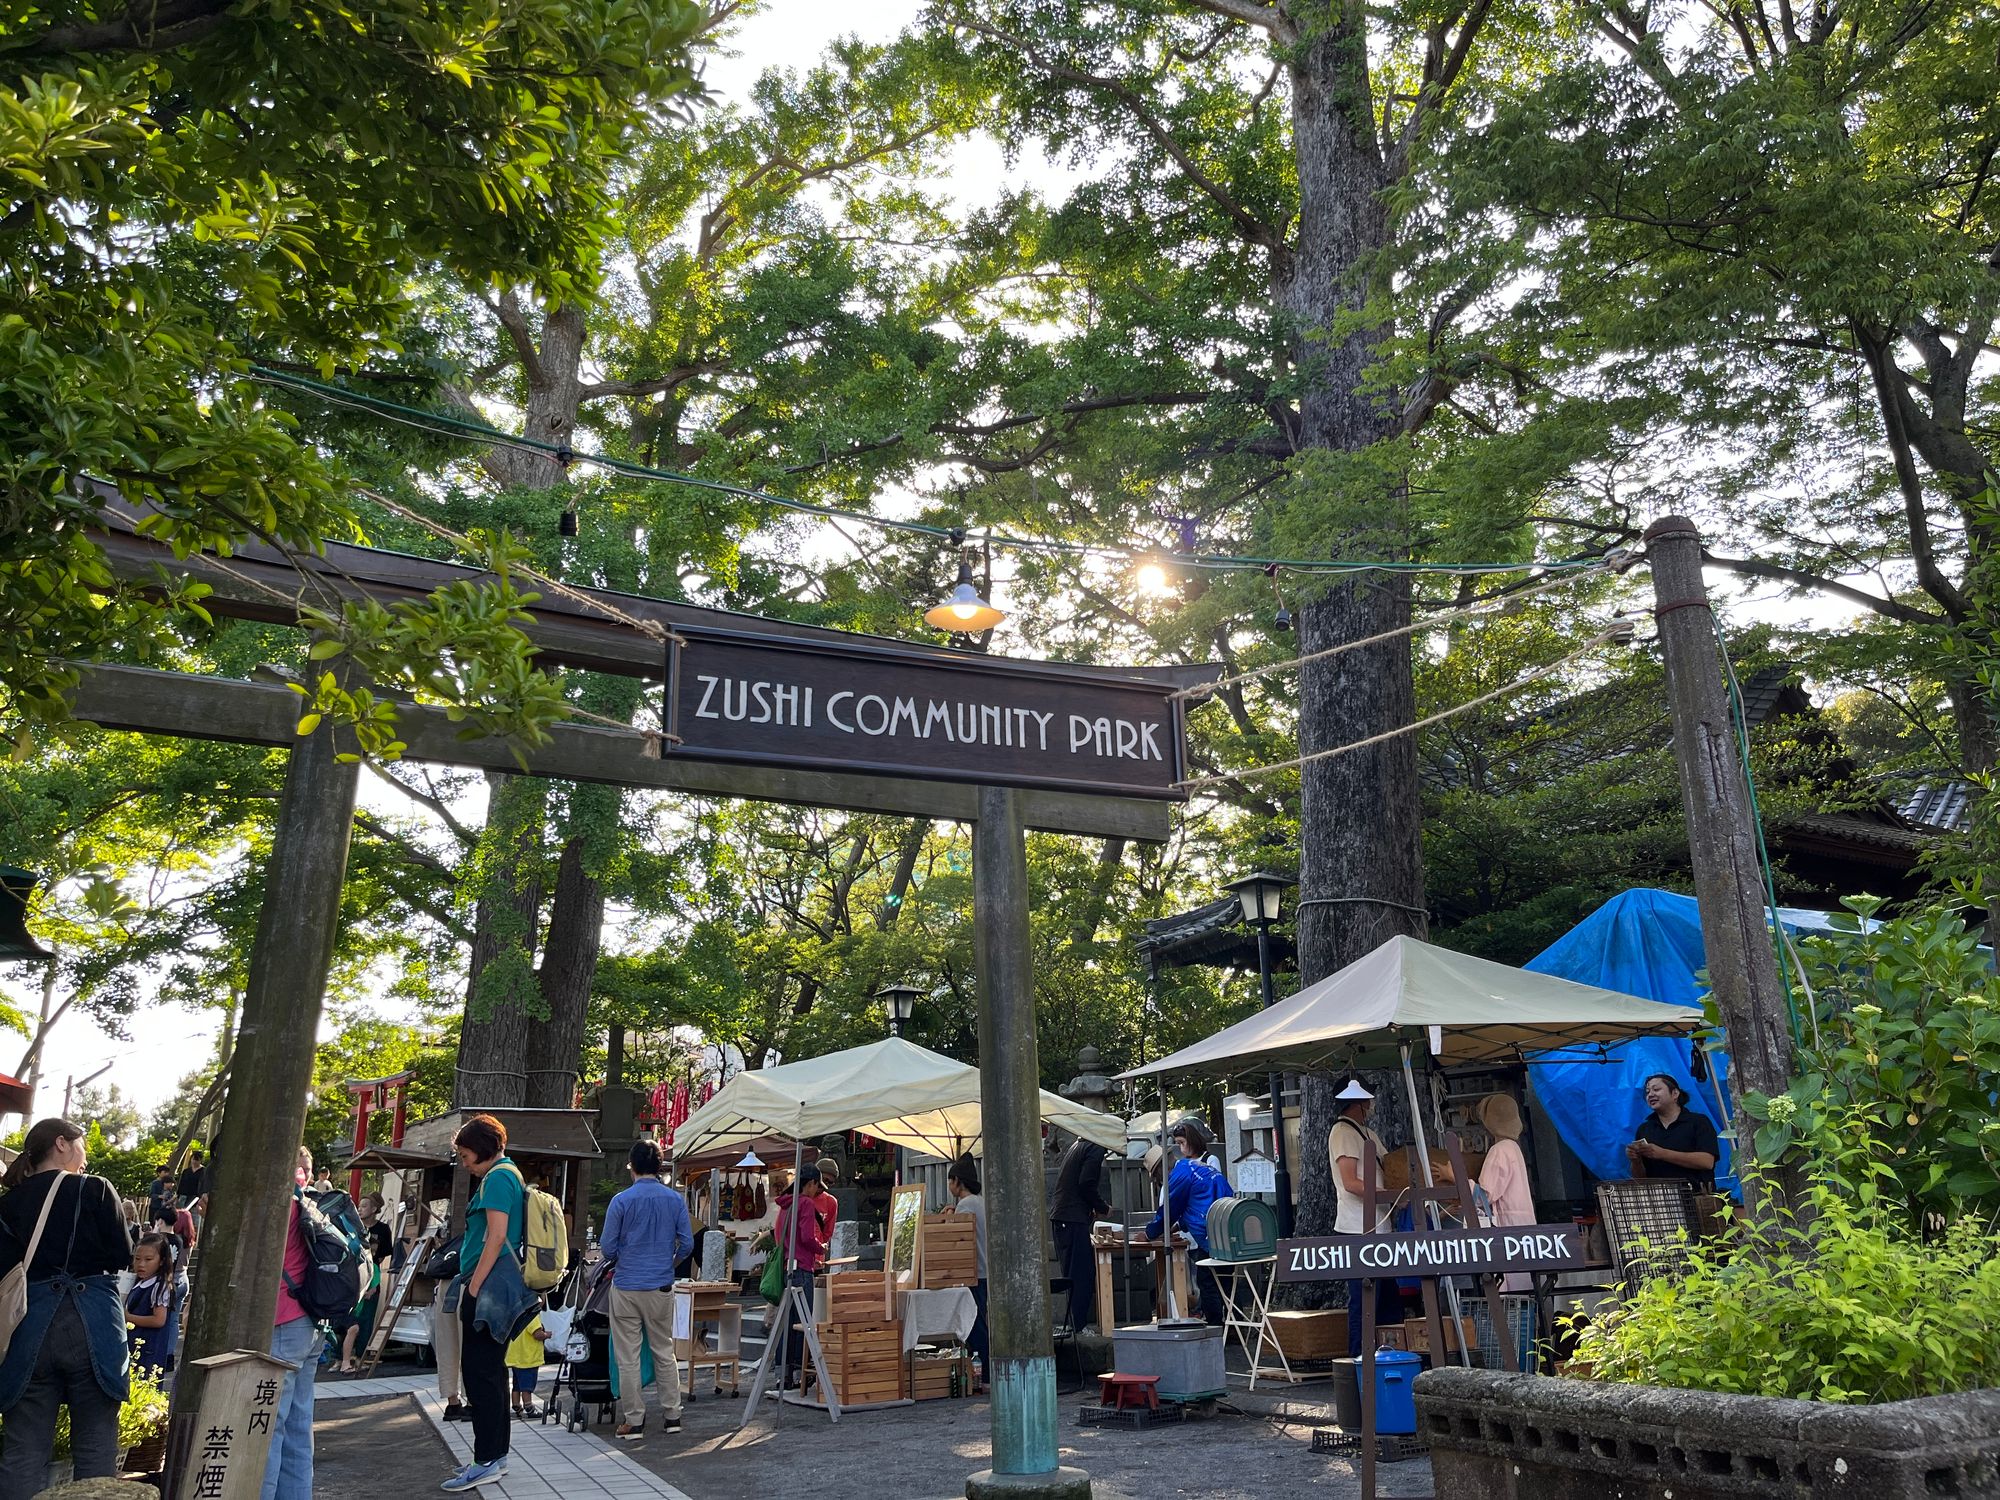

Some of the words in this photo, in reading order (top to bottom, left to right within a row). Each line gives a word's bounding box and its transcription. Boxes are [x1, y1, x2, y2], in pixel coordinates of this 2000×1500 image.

[695, 675, 813, 727] ZUSHI
[826, 690, 1054, 752] COMMUNITY
[1068, 714, 1164, 761] PARK
[1290, 1244, 1351, 1271] ZUSHI
[1359, 1237, 1494, 1267] COMMUNITY
[1504, 1233, 1572, 1261] PARK
[247, 1378, 278, 1435] 境内
[193, 1425, 234, 1499] 禁煙
